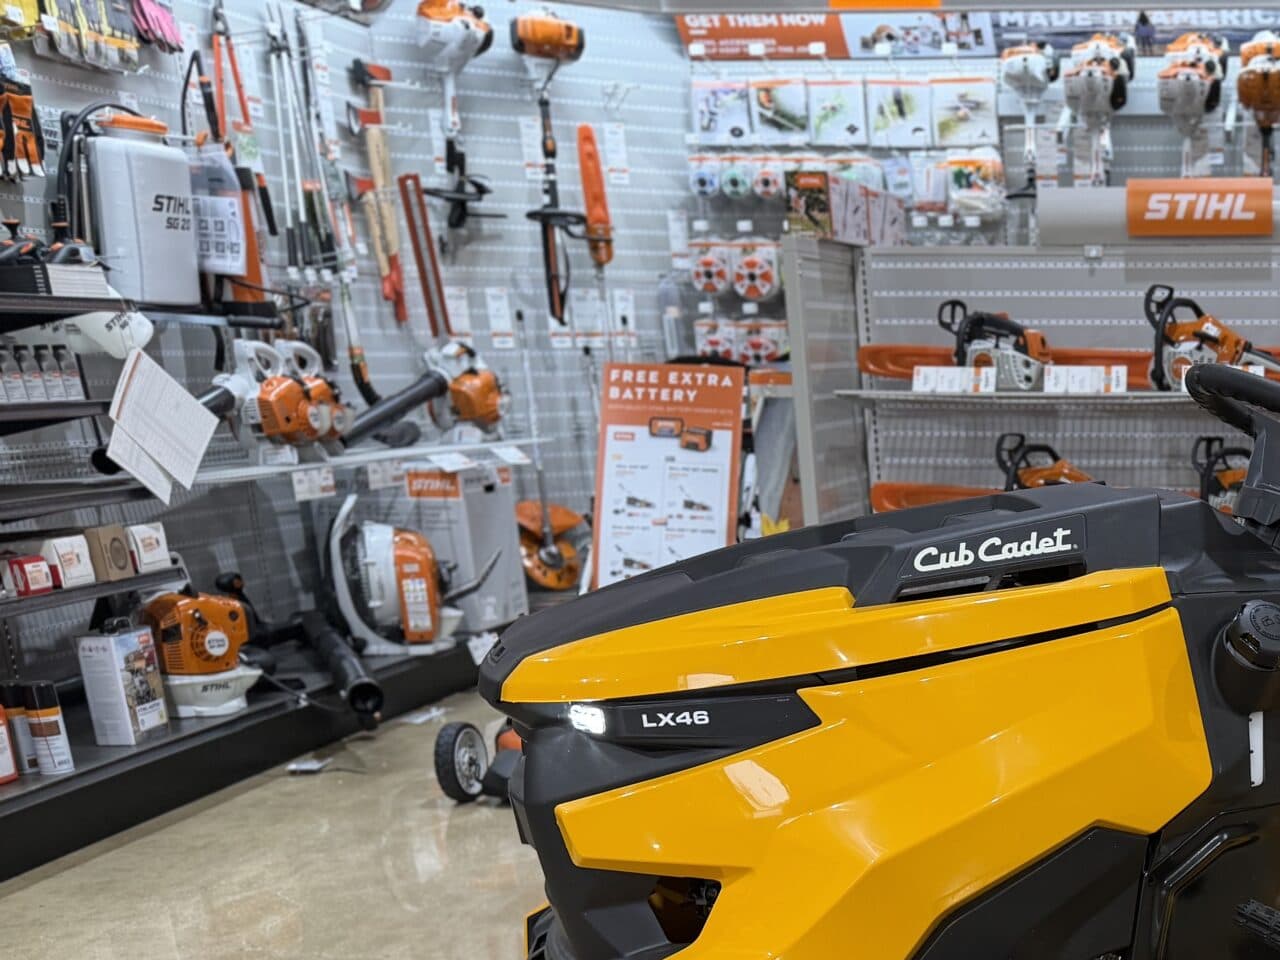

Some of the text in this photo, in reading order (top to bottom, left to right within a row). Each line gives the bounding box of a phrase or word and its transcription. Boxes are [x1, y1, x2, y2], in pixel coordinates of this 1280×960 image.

[685, 14, 826, 28] GET THEM NOW
[1001, 11, 1089, 27] MADE
[1144, 193, 1257, 220] STIHL
[165, 217, 180, 230] SG
[610, 369, 733, 387] FREE EXTRA
[608, 387, 698, 402] BATTERY
[412, 479, 455, 491] STIHL
[913, 527, 1072, 572] Cub Cadet
[641, 710, 710, 728] LX46
